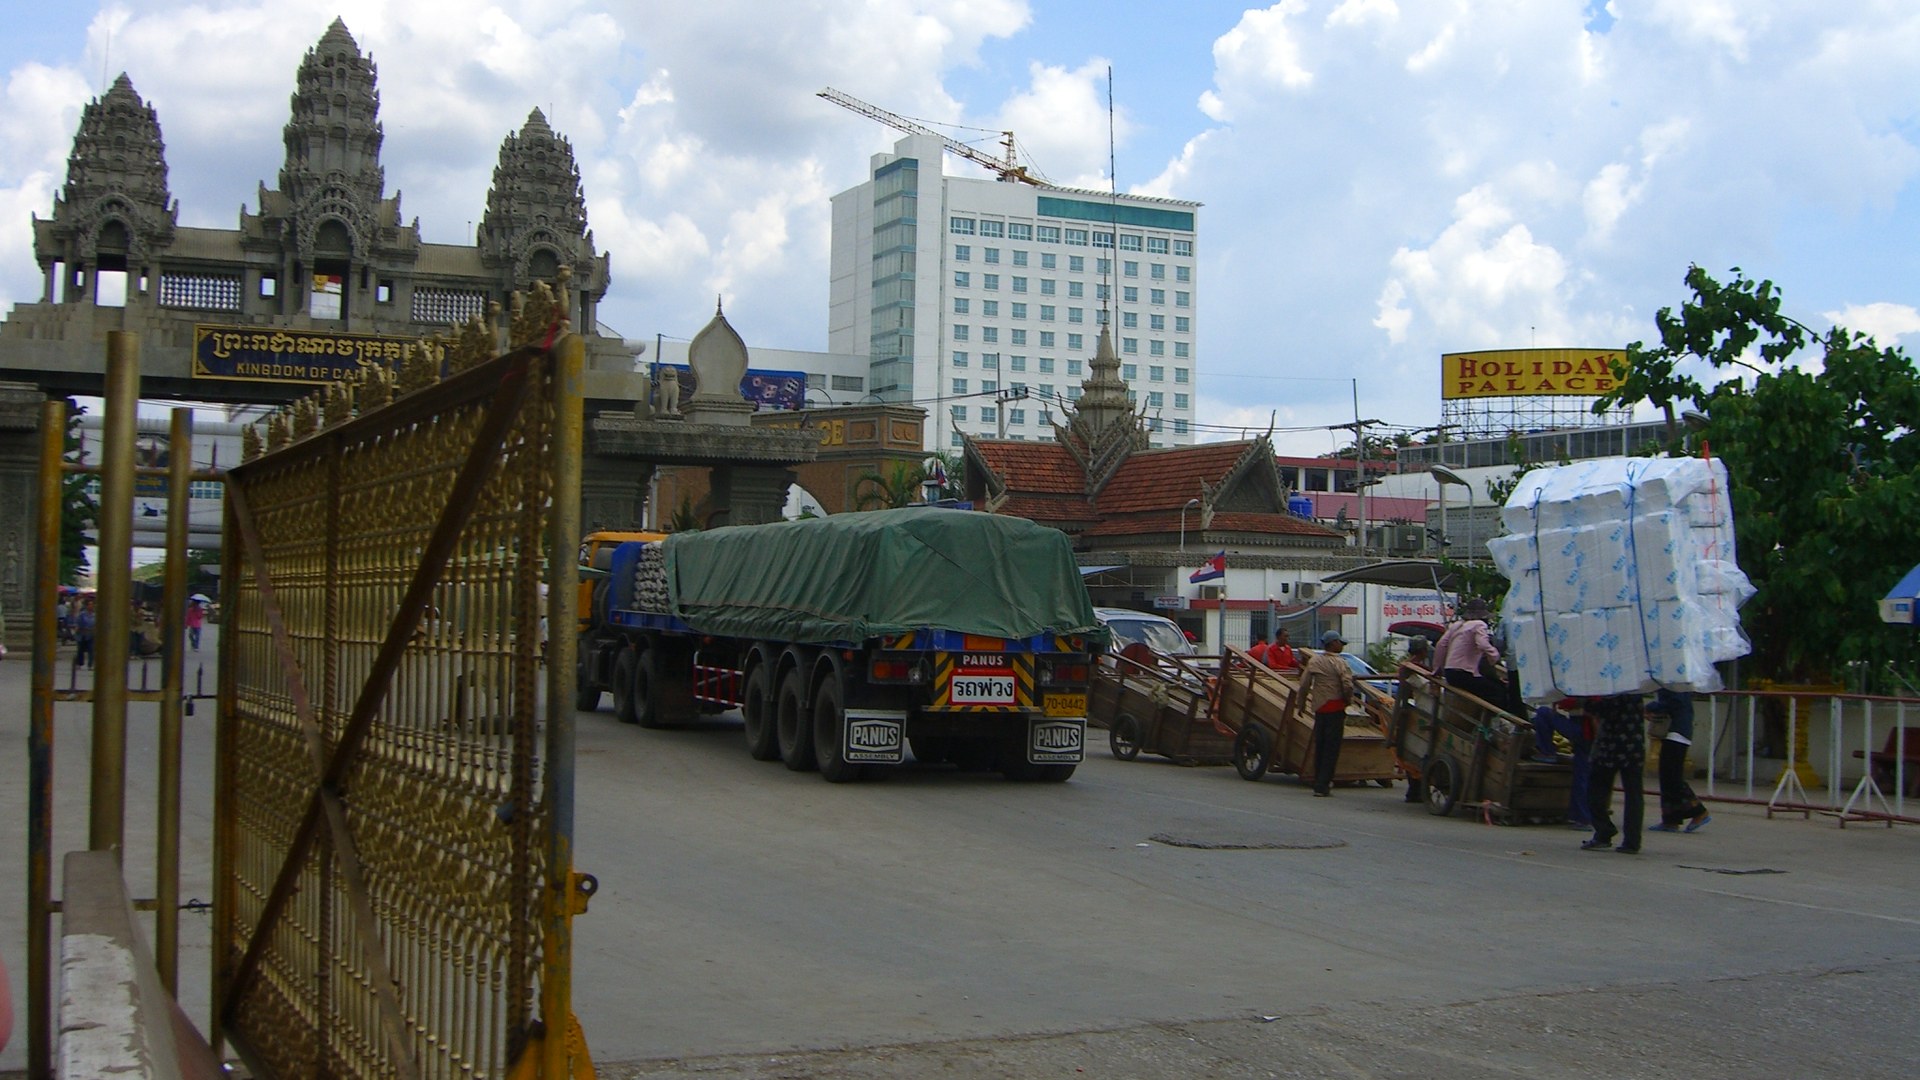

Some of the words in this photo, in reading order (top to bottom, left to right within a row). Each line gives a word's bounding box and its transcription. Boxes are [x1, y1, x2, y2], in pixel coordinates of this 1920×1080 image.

[236, 362, 306, 378] KINGDOM
[310, 367, 328, 380] OF
[1458, 354, 1615, 378] HOLIDAY
[1458, 378, 1614, 394] PALACE
[963, 655, 1003, 666] PANUS
[954, 677, 1013, 697] รถพ่วง
[853, 726, 897, 745] PANUS
[1036, 728, 1079, 747] PANUS
